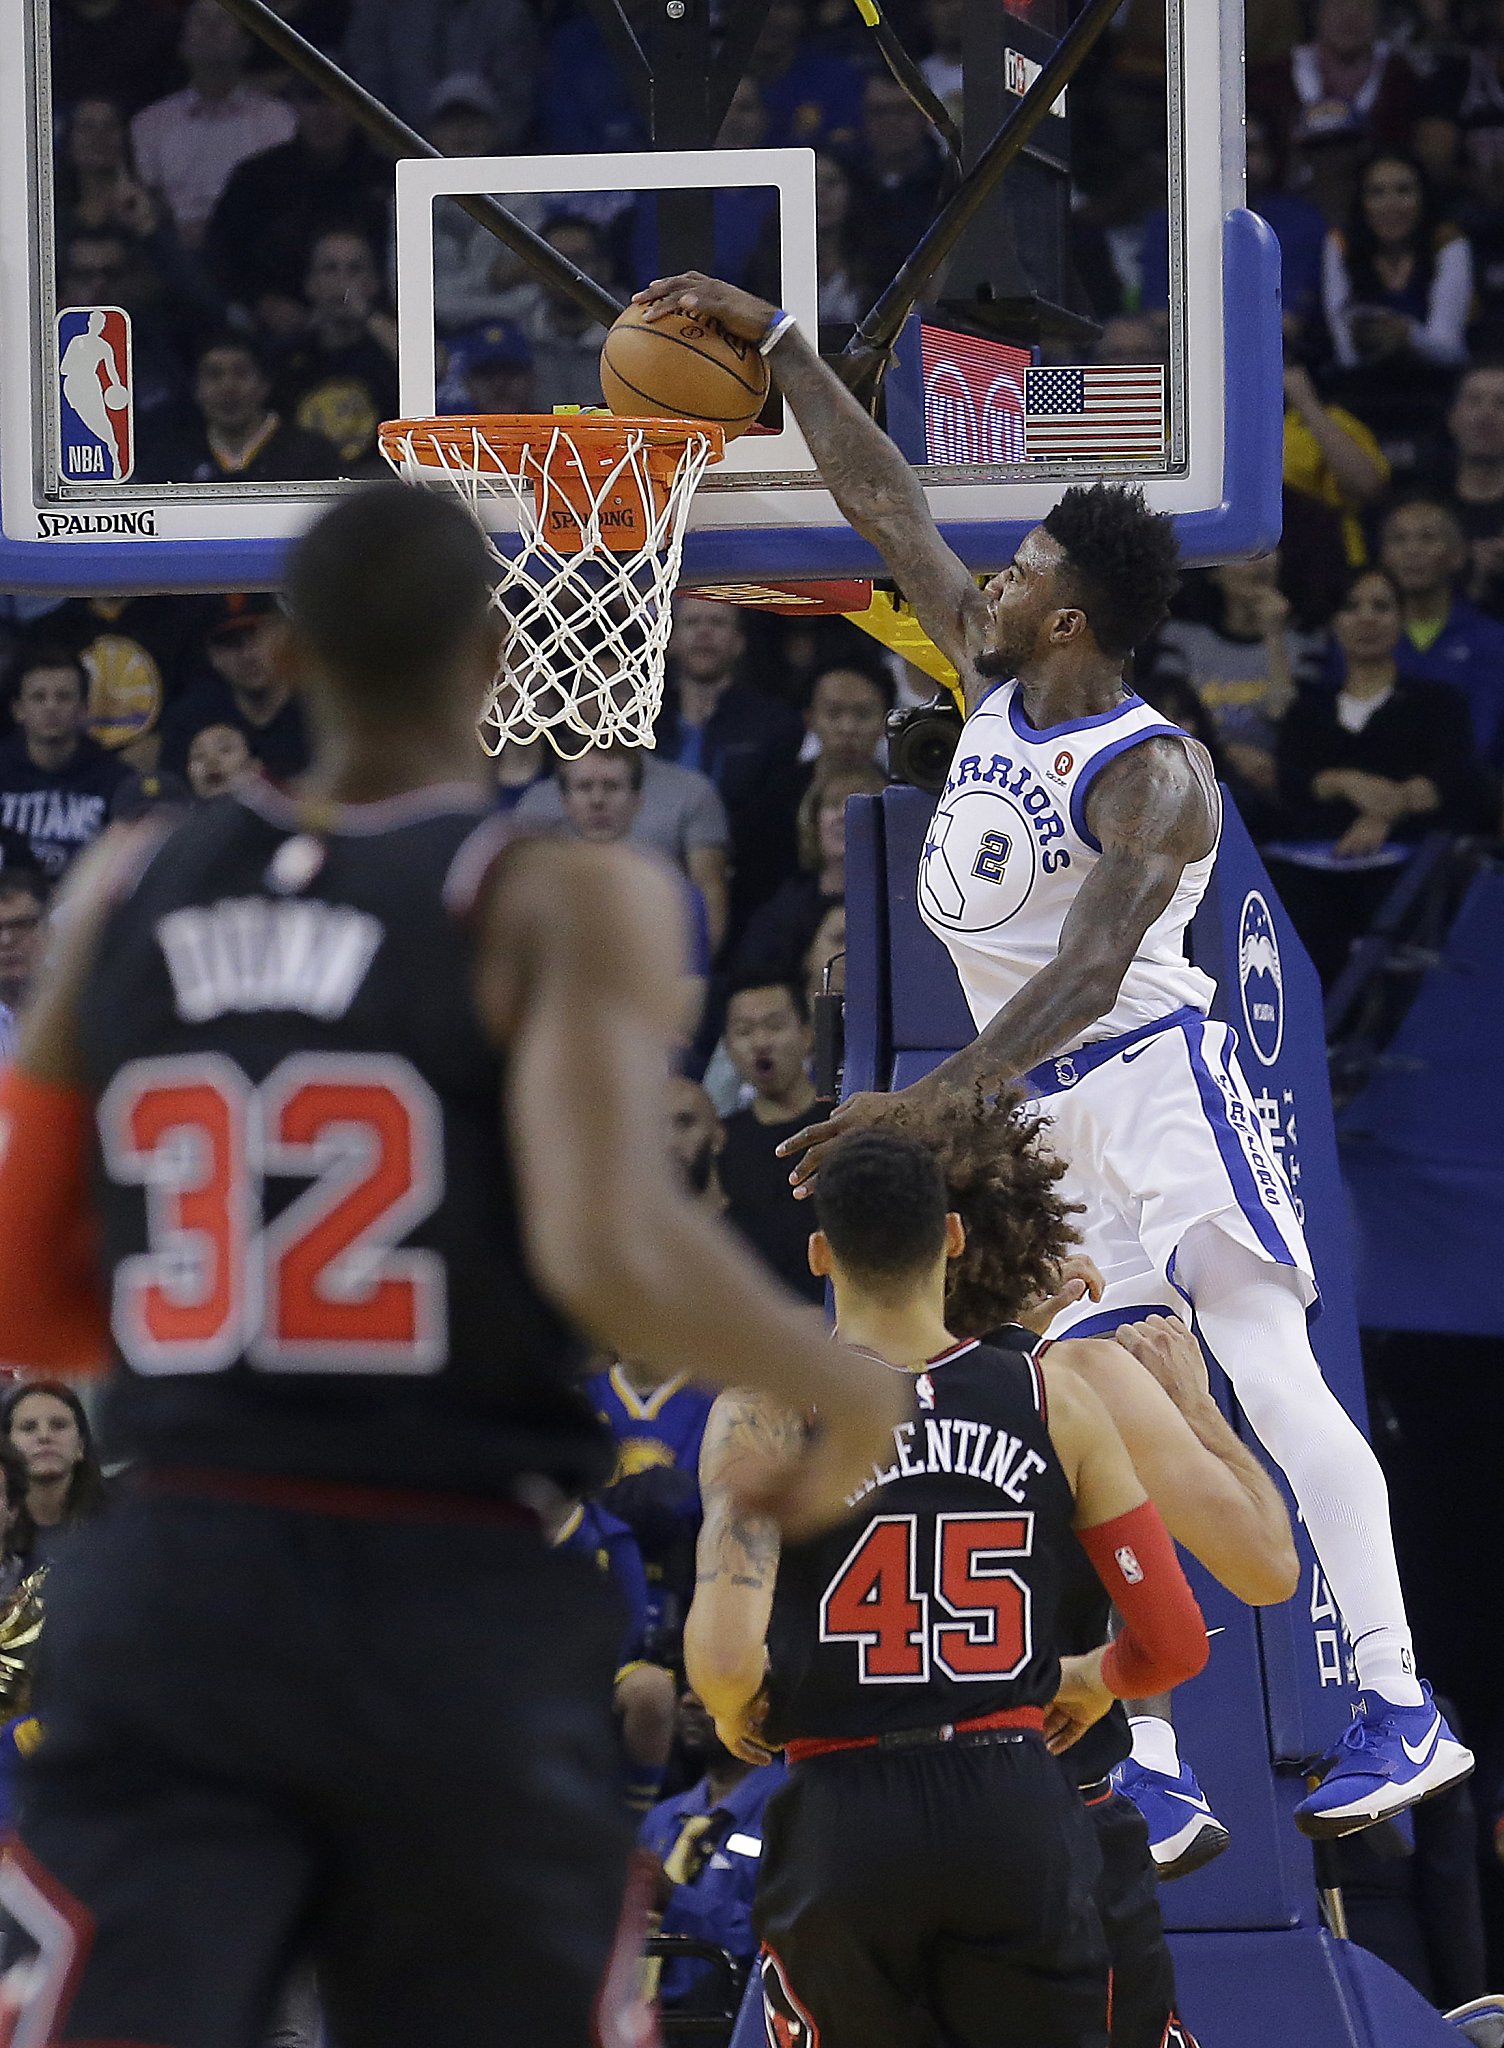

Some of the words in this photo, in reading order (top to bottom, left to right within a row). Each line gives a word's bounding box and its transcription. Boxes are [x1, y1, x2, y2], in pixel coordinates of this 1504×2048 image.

[68, 445, 105, 473] NBA
[37, 509, 155, 539] SPALDING
[551, 508, 634, 529] SPING
[948, 753, 1071, 874] RRIORS
[970, 829, 1013, 886] 2
[1215, 1074, 1281, 1206] RIORS
[96, 1050, 450, 1376] 32
[845, 1418, 1047, 1505] LENTINE
[818, 1510, 1035, 1685] 45
